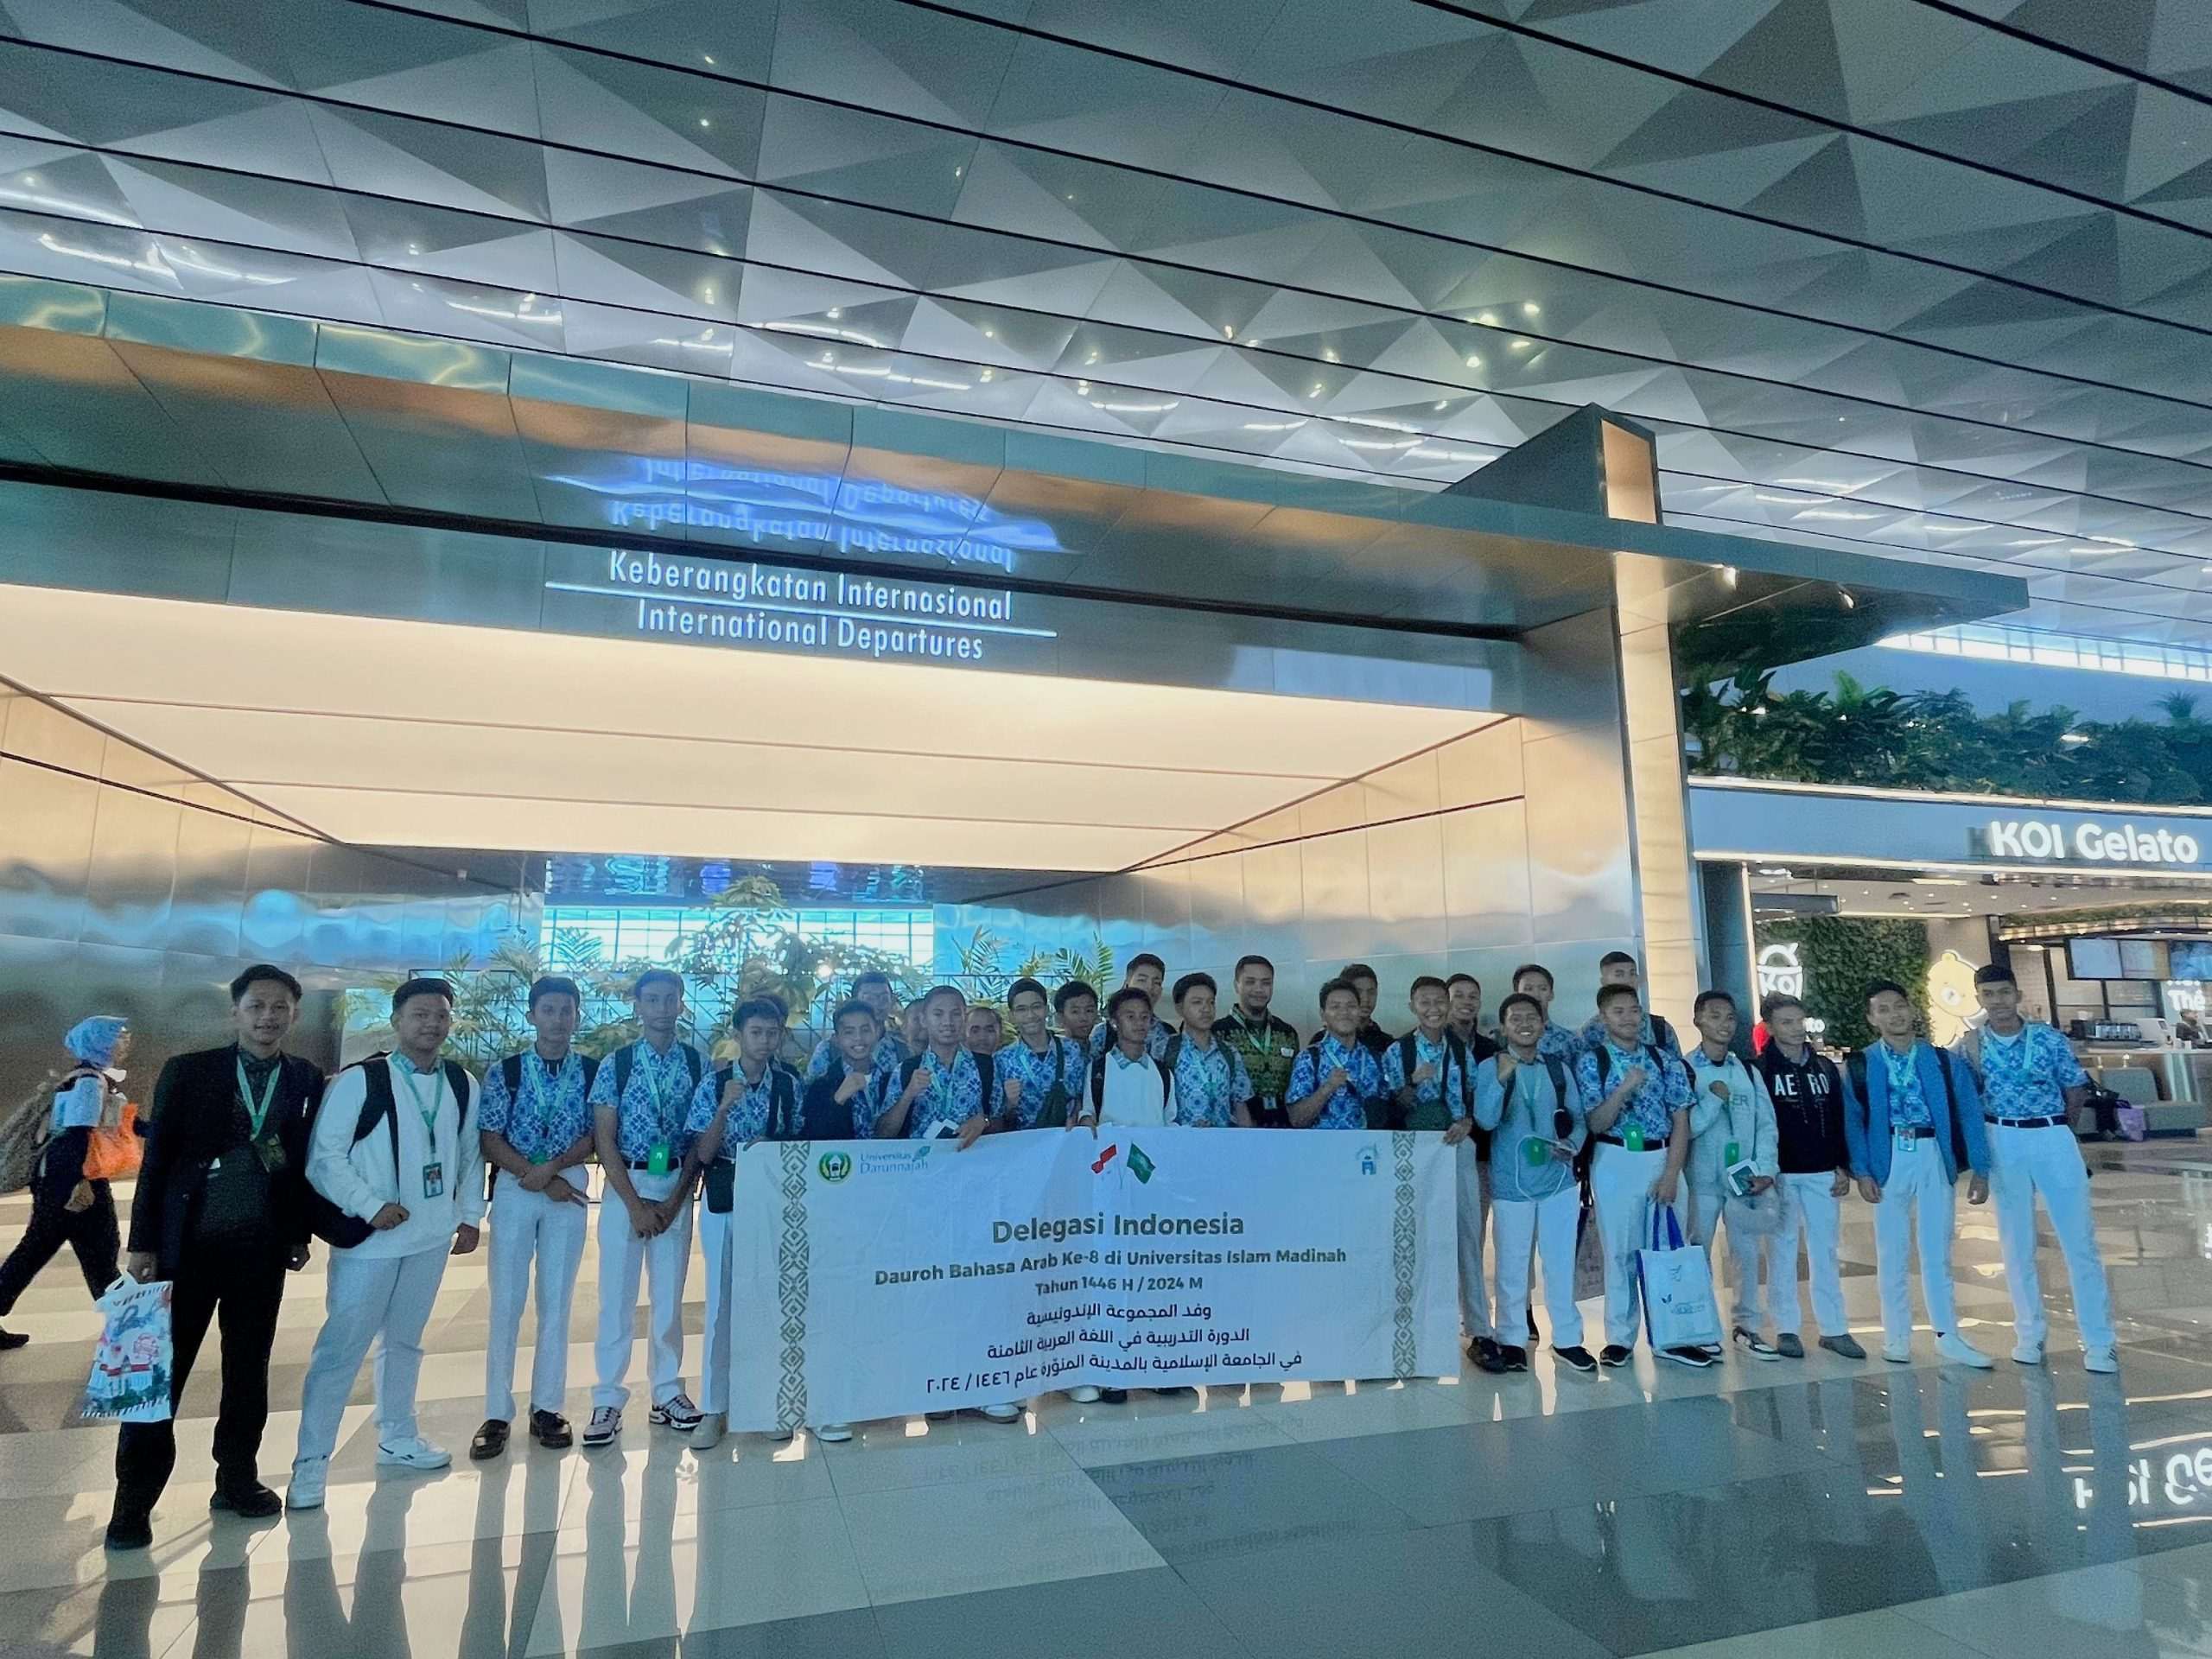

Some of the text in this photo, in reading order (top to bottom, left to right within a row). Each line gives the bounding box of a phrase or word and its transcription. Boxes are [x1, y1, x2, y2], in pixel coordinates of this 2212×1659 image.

[610, 550, 1012, 620] Keberangkatan Internasional
[638, 598, 983, 659] International Departures
[1990, 821, 2198, 863] KOI Gelato
[860, 1152, 913, 1162] Universitas
[860, 1159, 929, 1174] Darunnajah
[993, 1211, 1245, 1243] Delegasi Indonesia
[874, 1248, 1346, 1286] Dauroh Bahasa Arab Ke-8 di Universitas Islam Madinah
[1035, 1279, 1078, 1296] Tahun
[1082, 1275, 1117, 1290] 1446
[1122, 1278, 1134, 1291] H
[1147, 1276, 1185, 1291] 2024
[1189, 1276, 1204, 1290] M
[1027, 1302, 1211, 1327] وفد المجموعة الإندونيسية
[988, 1328, 1249, 1359] الدورة التدريبية في اللغة العربية الثامنة
[1089, 1354, 1147, 1373] بالمدينة
[1152, 1354, 1217, 1372] الإسلامية
[1222, 1352, 1275, 1370] الجامعة
[1280, 1351, 1302, 1371] في
[1014, 1365, 1038, 1389] عام
